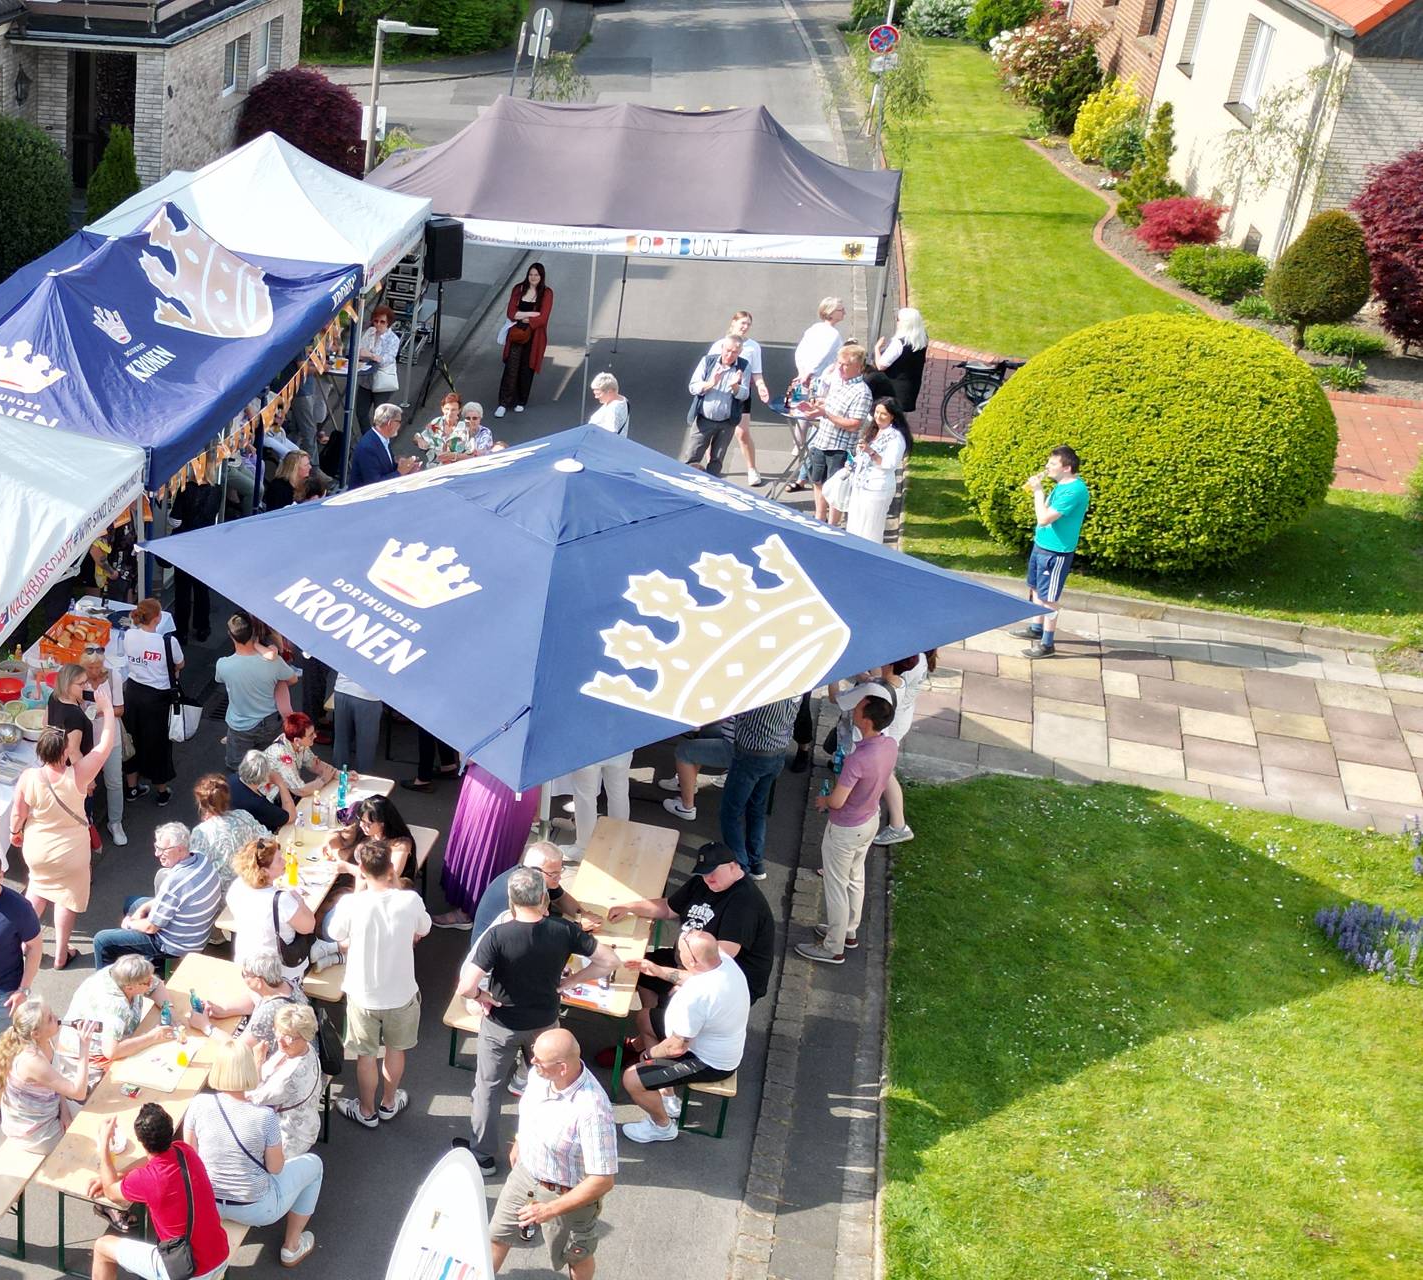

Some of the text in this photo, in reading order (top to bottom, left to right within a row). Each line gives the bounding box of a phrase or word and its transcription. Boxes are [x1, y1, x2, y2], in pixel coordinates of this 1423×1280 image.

[125, 344, 177, 384] KRONEN
[274, 577, 427, 675] KRONEN
[332, 578, 423, 634] DORTMUNDER
[127, 655, 148, 666] radio
